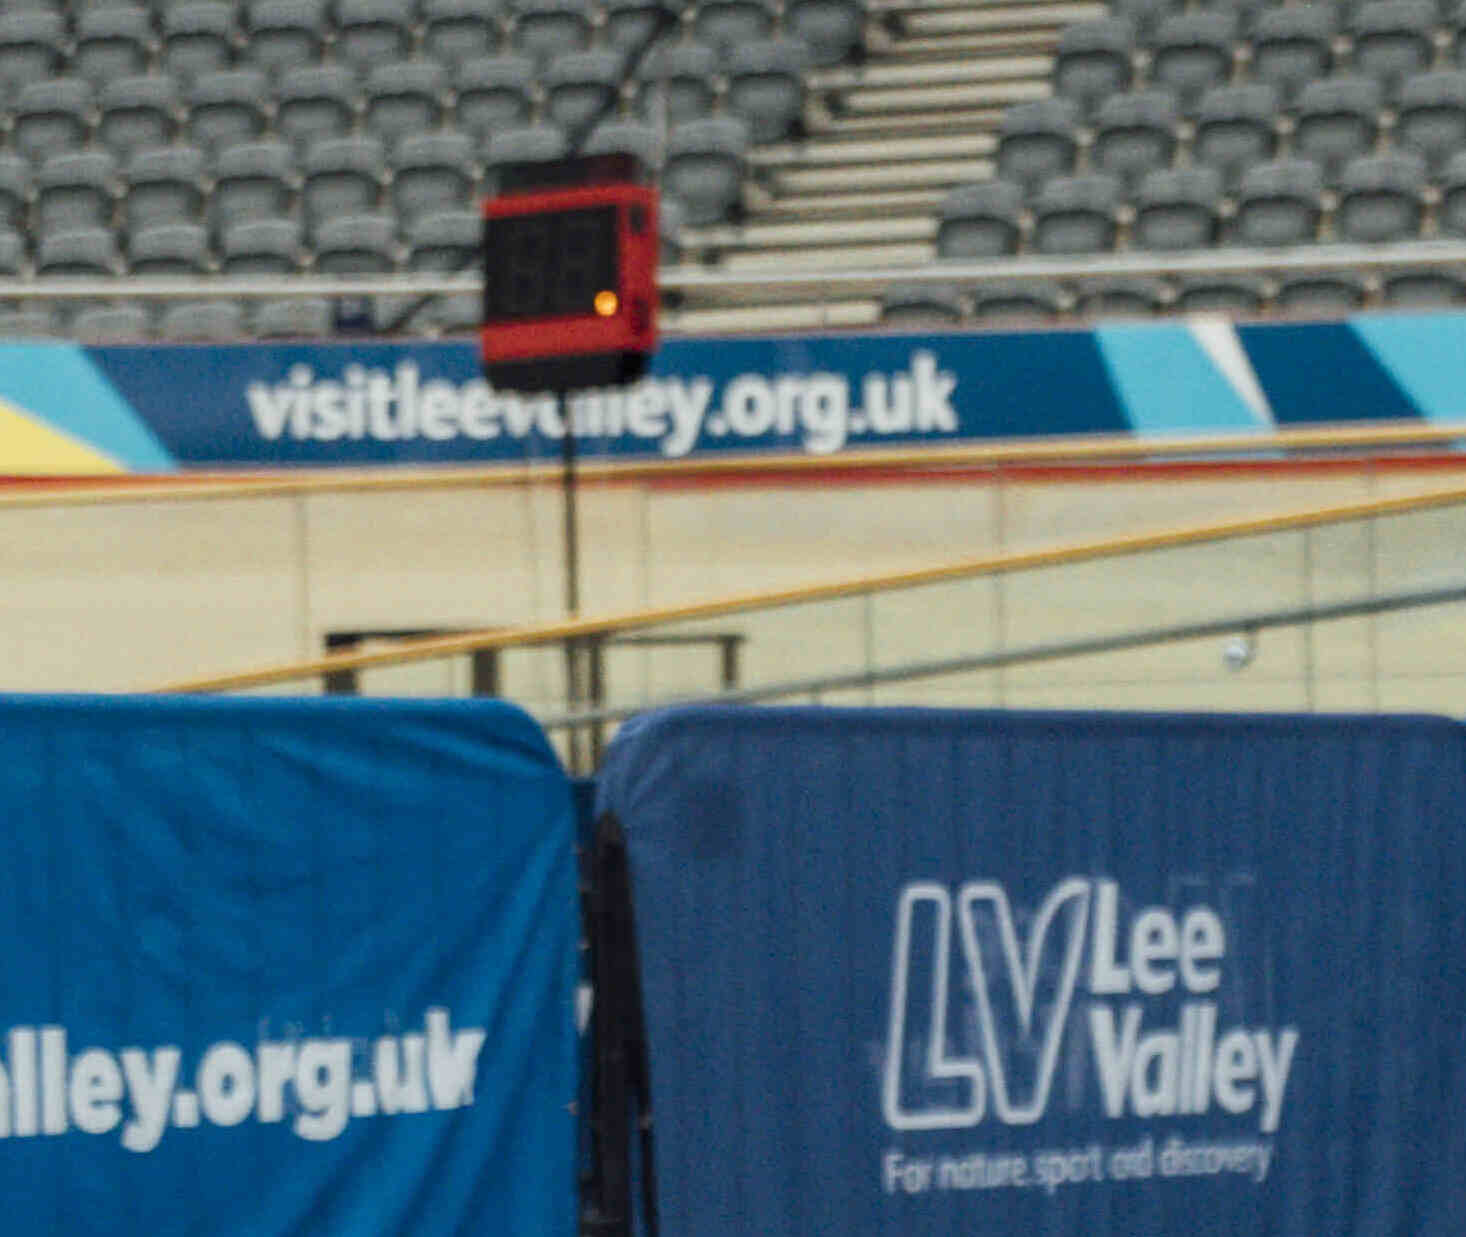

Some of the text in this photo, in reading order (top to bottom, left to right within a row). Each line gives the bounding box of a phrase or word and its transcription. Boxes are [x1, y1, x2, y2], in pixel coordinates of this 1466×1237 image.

[1088, 879, 1225, 995] Lee
[883, 876, 1090, 1130] LV
[1089, 1003, 1300, 1132] Valley
[0, 1007, 487, 1153] lley.org.uk
[884, 1152, 932, 1196] For
[1034, 1145, 1103, 1196] sport
[1109, 1135, 1156, 1181] and
[1158, 1138, 1274, 1184] discovery
